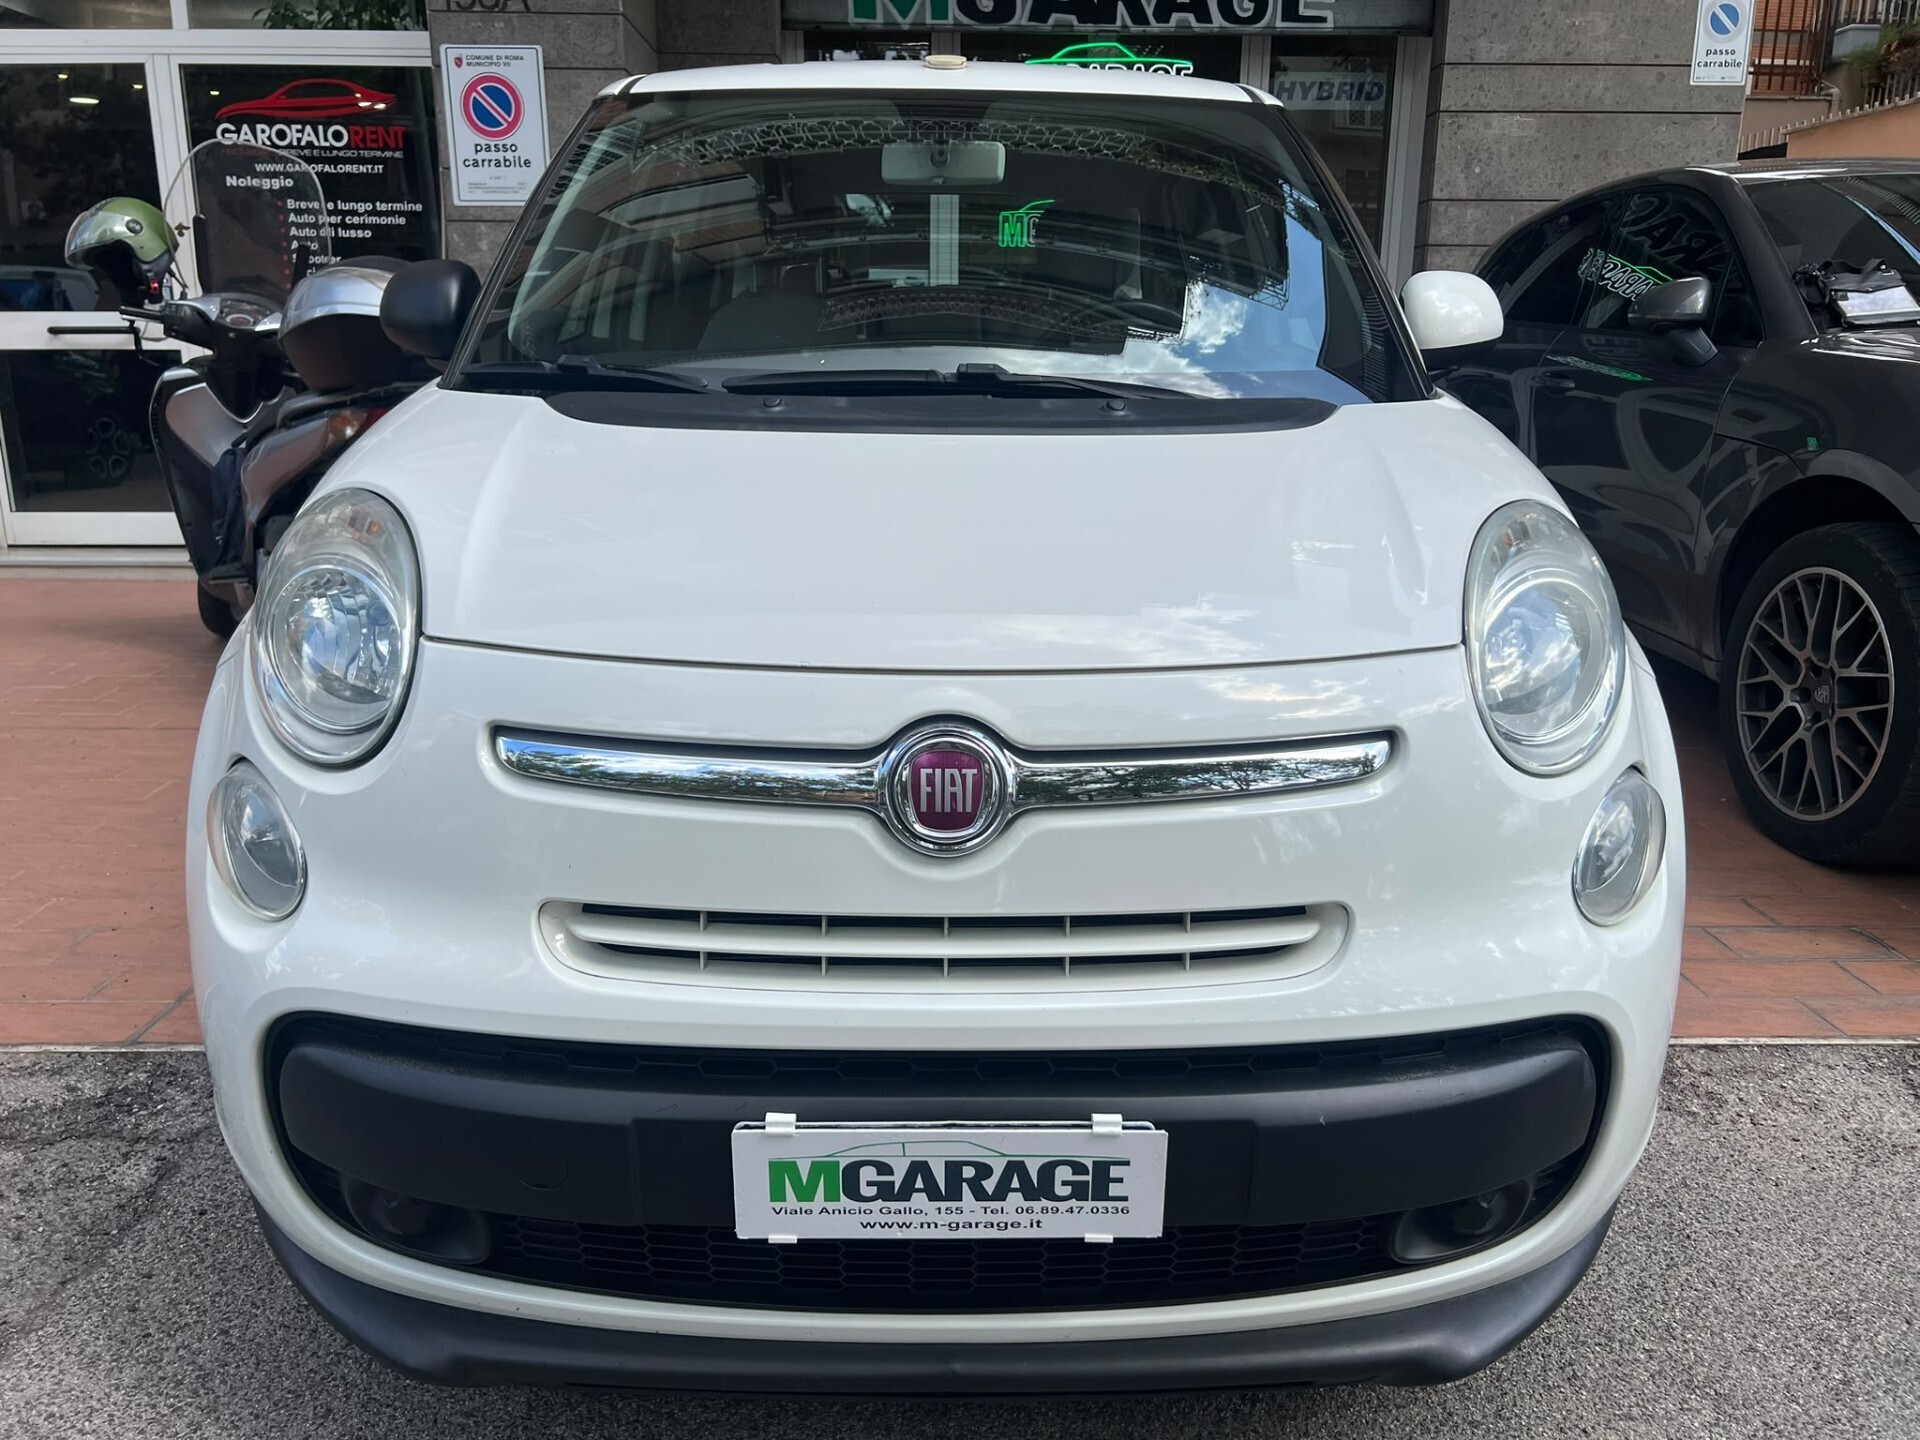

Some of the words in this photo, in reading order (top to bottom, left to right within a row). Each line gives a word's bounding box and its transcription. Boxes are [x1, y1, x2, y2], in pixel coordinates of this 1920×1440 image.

[1706, 48, 1736, 57] passo
[1697, 59, 1742, 68] carrabile
[1275, 81, 1385, 101] HYBRID
[216, 122, 405, 148] GAROFALORENT
[321, 150, 357, 158] LUNGO
[358, 150, 404, 159] TERMINE
[474, 143, 518, 155] passo
[463, 155, 531, 168] carrabile
[225, 176, 294, 189] Noleggio
[287, 199, 320, 210] Breve
[327, 202, 334, 210] e
[337, 200, 373, 213] lungo
[375, 201, 423, 212] termine
[288, 213, 316, 223] Auto
[345, 214, 406, 225] cerimonie
[290, 226, 317, 237] Auto
[338, 227, 372, 238] lusso
[920, 768, 978, 813] FIAT
[768, 1159, 1131, 1203] MGARAGE
[772, 1206, 814, 1216] Viale
[818, 1206, 873, 1215] Anicio
[878, 1206, 928, 1217] Gallo,
[934, 1206, 964, 1215] 155
[980, 1206, 1009, 1215] Tel.
[1015, 1206, 1130, 1215] 06.89.47.0336
[860, 1218, 1043, 1231] www.m-garage.it
